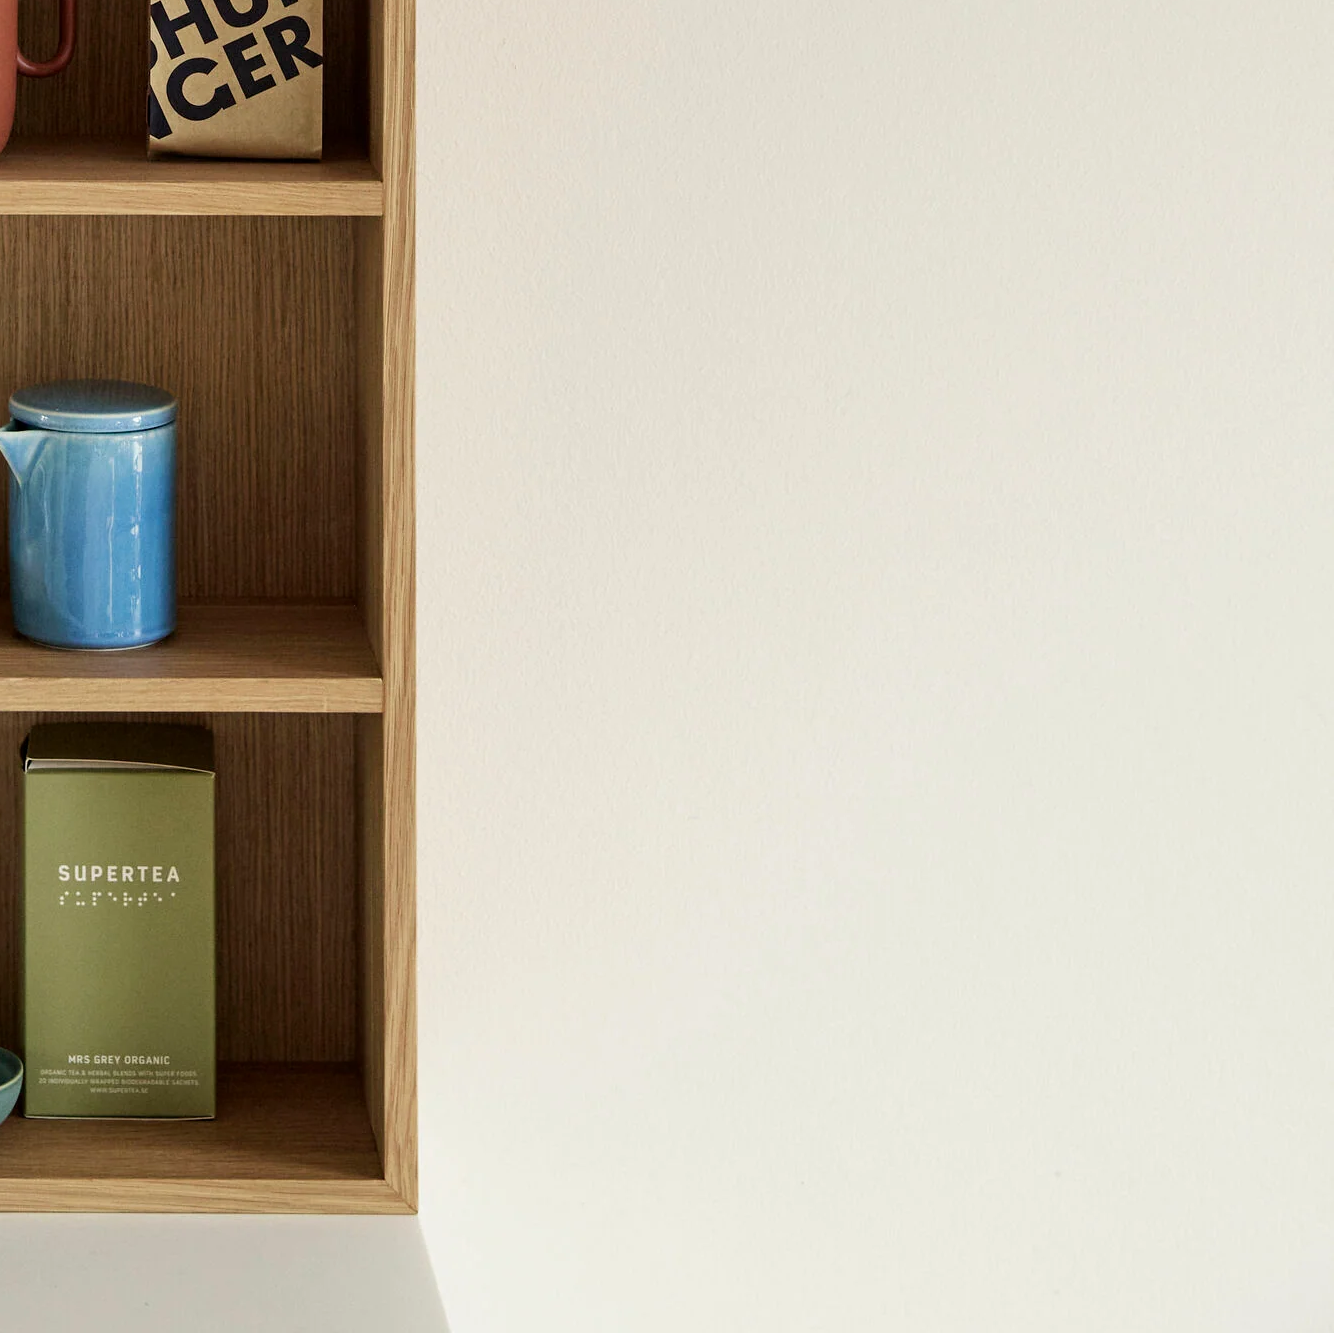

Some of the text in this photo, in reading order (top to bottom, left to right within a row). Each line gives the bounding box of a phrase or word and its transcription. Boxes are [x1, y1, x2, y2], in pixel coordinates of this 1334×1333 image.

[58, 864, 180, 882] SUPERTEA
[68, 1055, 171, 1065] MRS GREY ORGANIC
